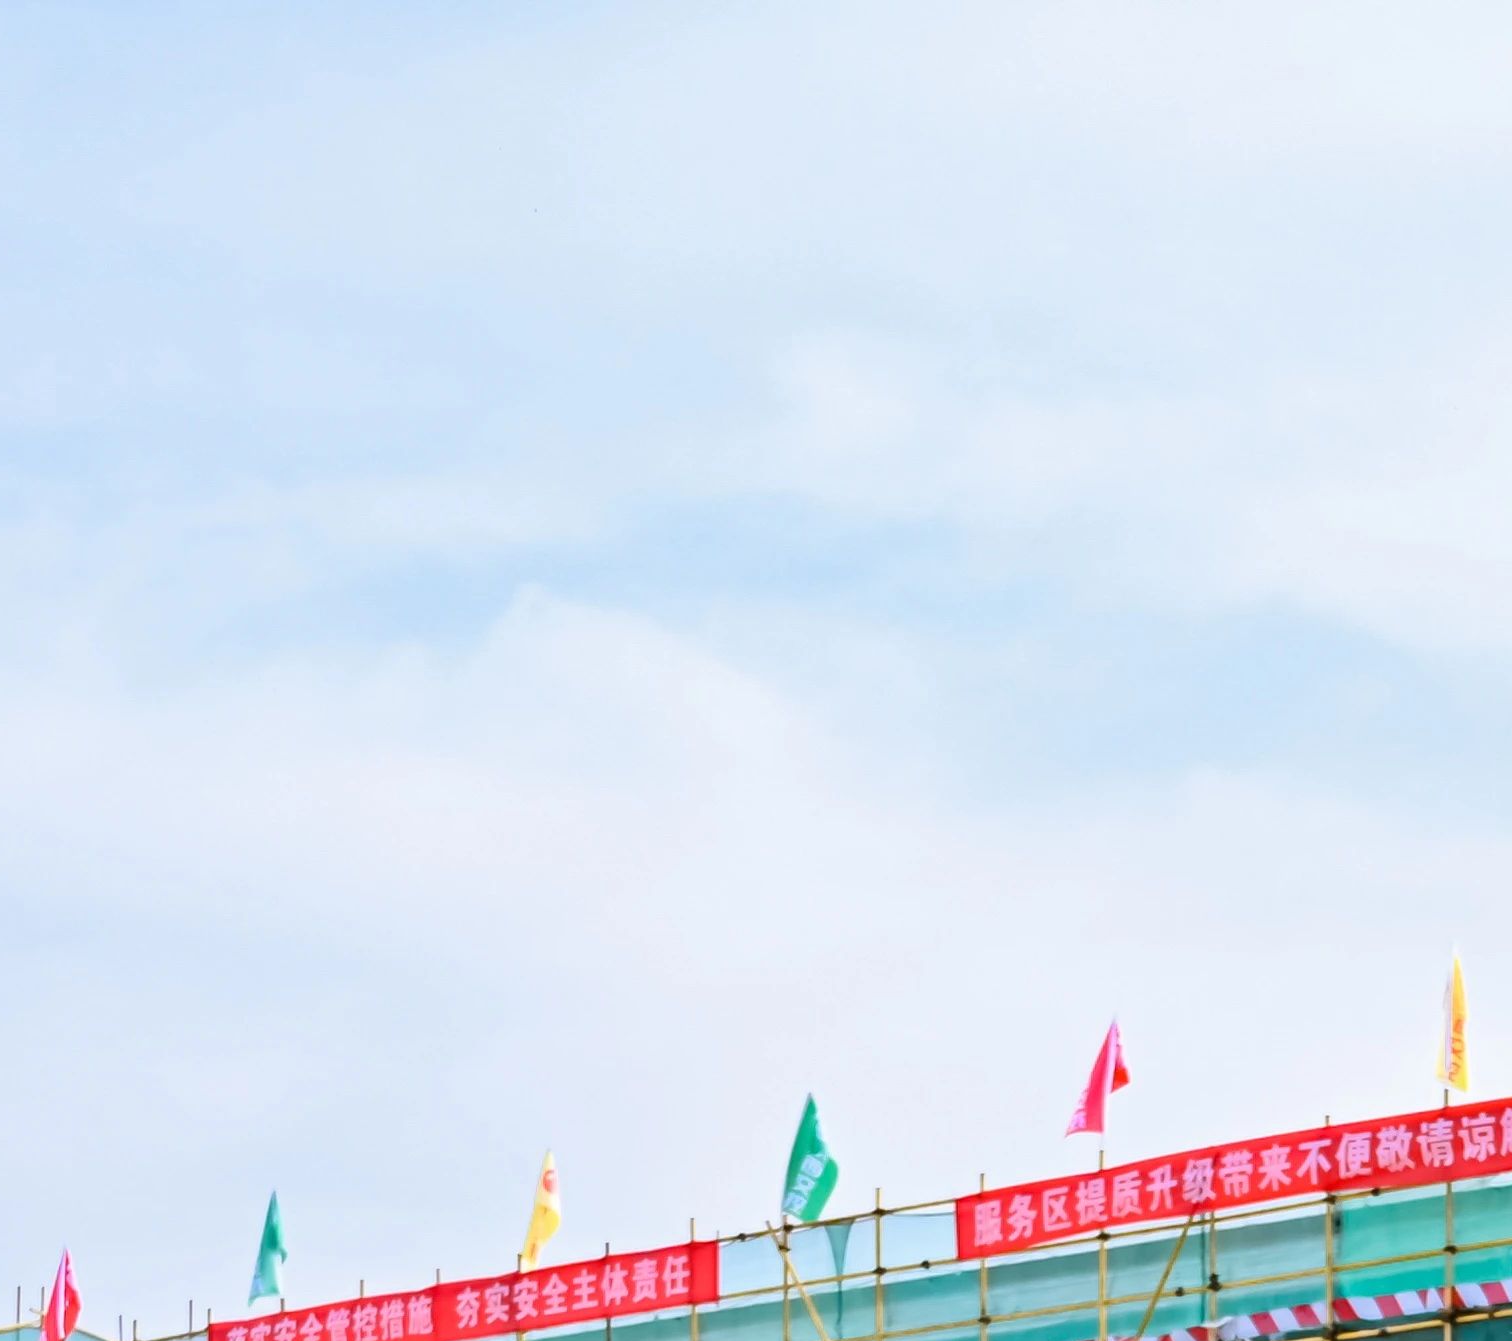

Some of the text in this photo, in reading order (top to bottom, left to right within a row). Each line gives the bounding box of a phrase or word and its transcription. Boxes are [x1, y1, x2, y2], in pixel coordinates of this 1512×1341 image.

[454, 1254, 692, 1330] 夯实安全主体责任
